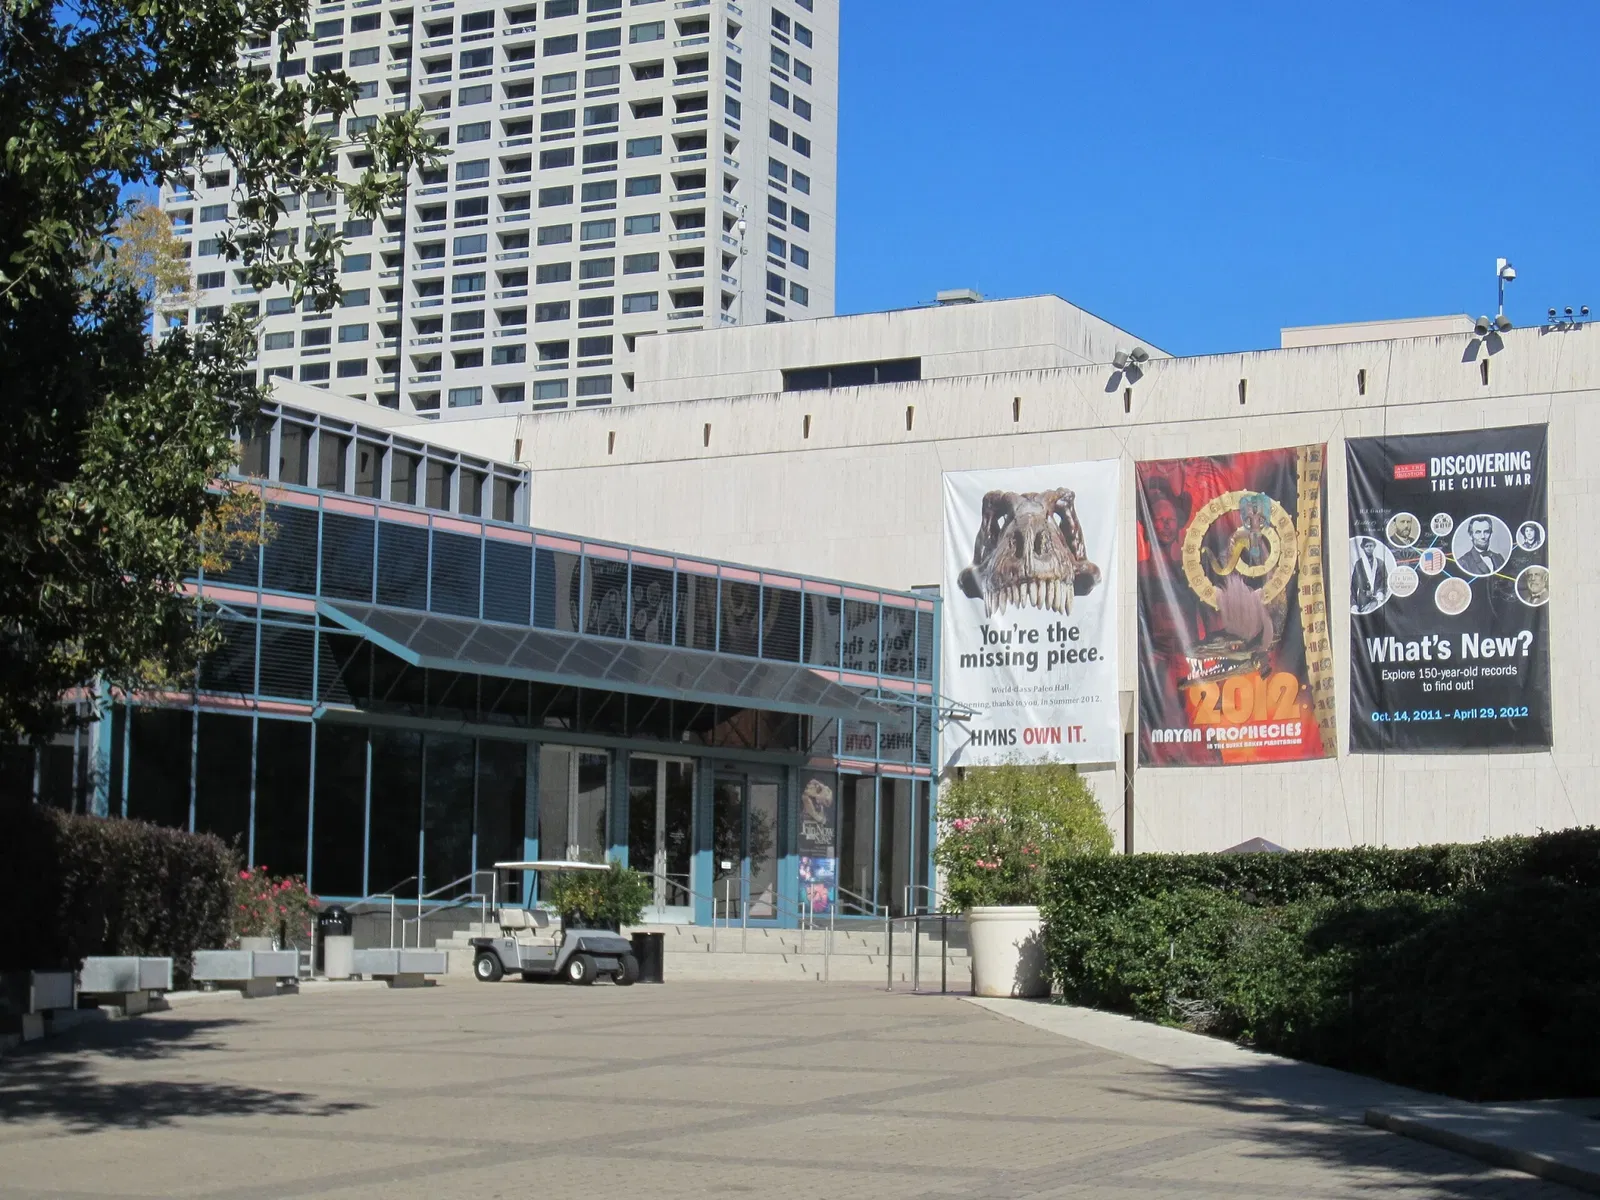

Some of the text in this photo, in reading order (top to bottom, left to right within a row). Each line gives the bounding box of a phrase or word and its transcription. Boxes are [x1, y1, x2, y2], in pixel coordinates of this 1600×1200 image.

[1430, 450, 1532, 477] DISCOVERING
[1431, 473, 1532, 492] THE CIVIL WAR
[980, 621, 1080, 645] You're the
[1366, 630, 1534, 663] What's New?
[960, 643, 1105, 672] missing piece.
[1382, 664, 1518, 682] Explore 150-year-old records
[1033, 685, 1054, 693] Paleo
[1422, 679, 1475, 692] to find out!
[992, 699, 1015, 707] thanks
[1049, 697, 1079, 706] Summer
[1371, 711, 1391, 722] Oct.
[1393, 710, 1411, 723] 14,
[1413, 709, 1442, 720] 2011
[1453, 708, 1478, 721] April
[1479, 707, 1497, 720] 29,
[1500, 706, 1529, 718] 2012
[970, 725, 1087, 747] HMNS OWN IT.
[1151, 722, 1302, 743] MAYAN PROPHECIES
